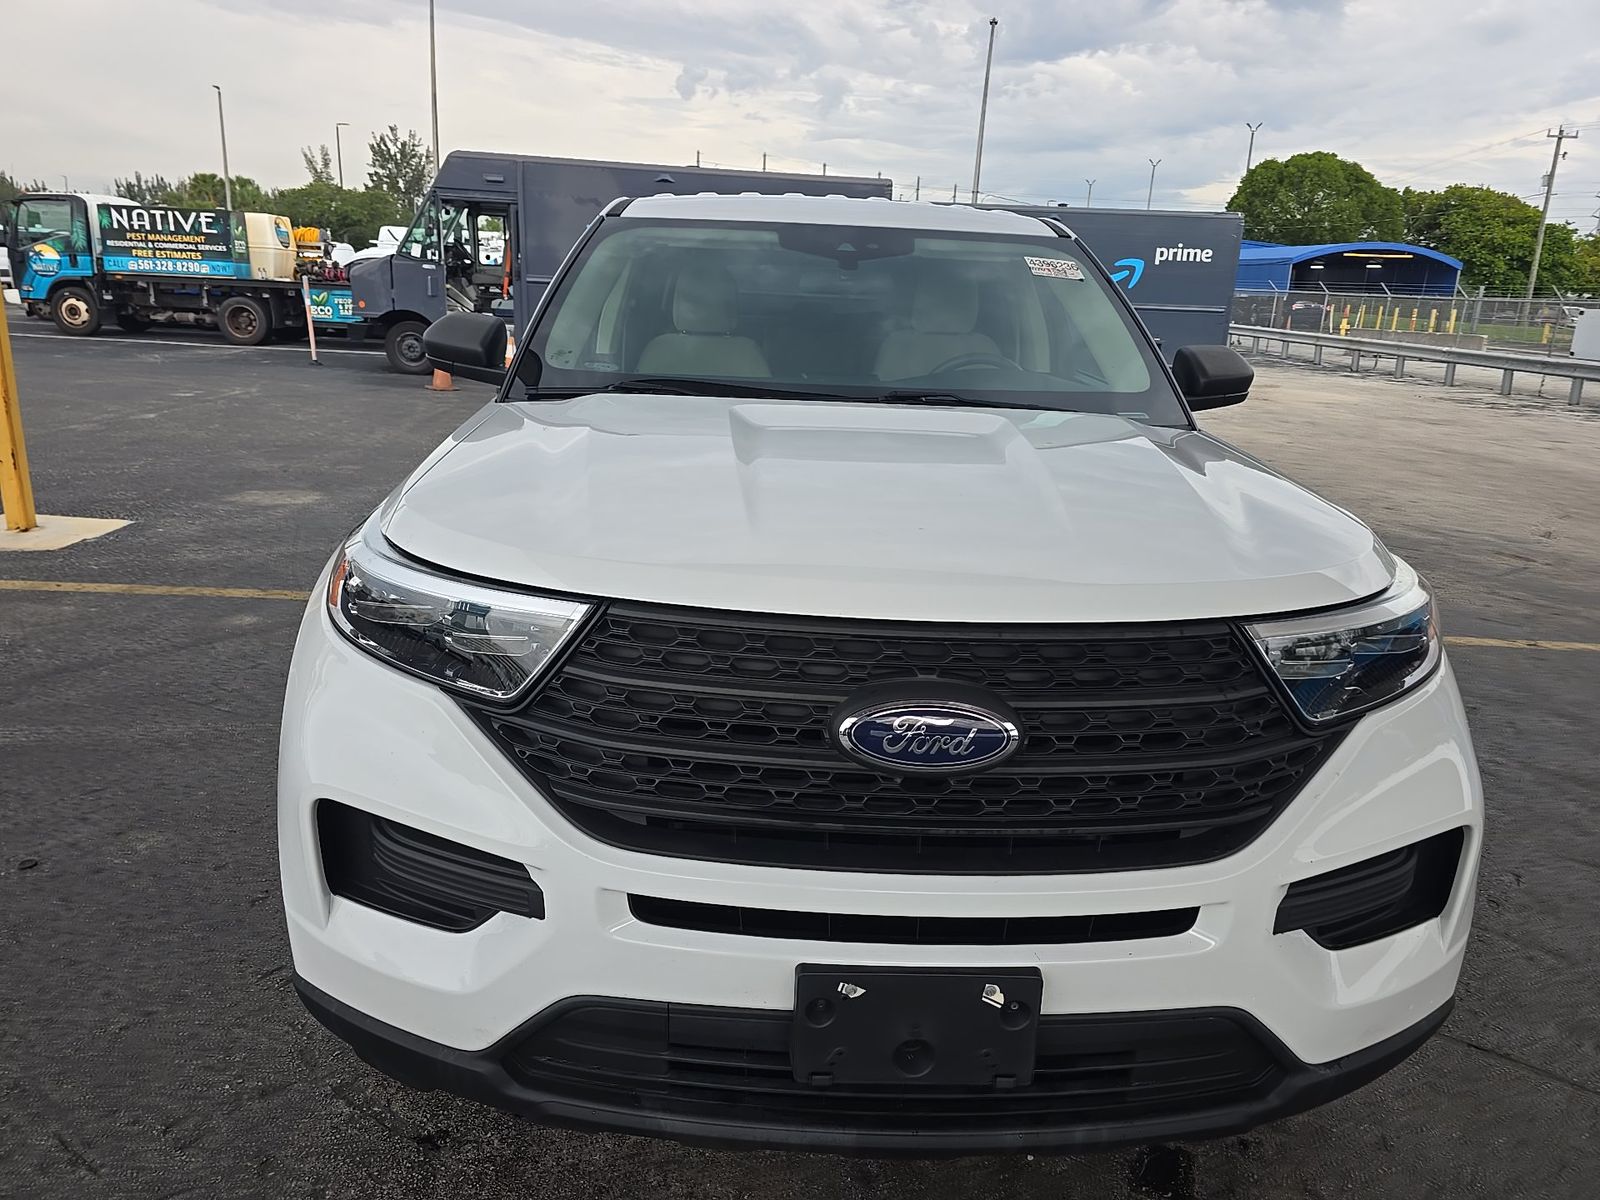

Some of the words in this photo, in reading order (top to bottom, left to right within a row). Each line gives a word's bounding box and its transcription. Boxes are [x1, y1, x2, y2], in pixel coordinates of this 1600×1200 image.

[110, 206, 218, 234] NATIVE
[126, 232, 146, 240] PEST
[147, 234, 206, 244] MANAGEMENT
[106, 240, 147, 248] RESIDENTIAL
[154, 243, 197, 251] COMMERCIAL
[197, 244, 227, 252] SERVICES
[132, 249, 154, 258] FREE
[155, 250, 202, 260] ESTIMATES
[1154, 242, 1213, 266] prime
[137, 259, 200, 273] 561-328-8290
[310, 305, 333, 316] ECO
[882, 715, 978, 756] Ford
